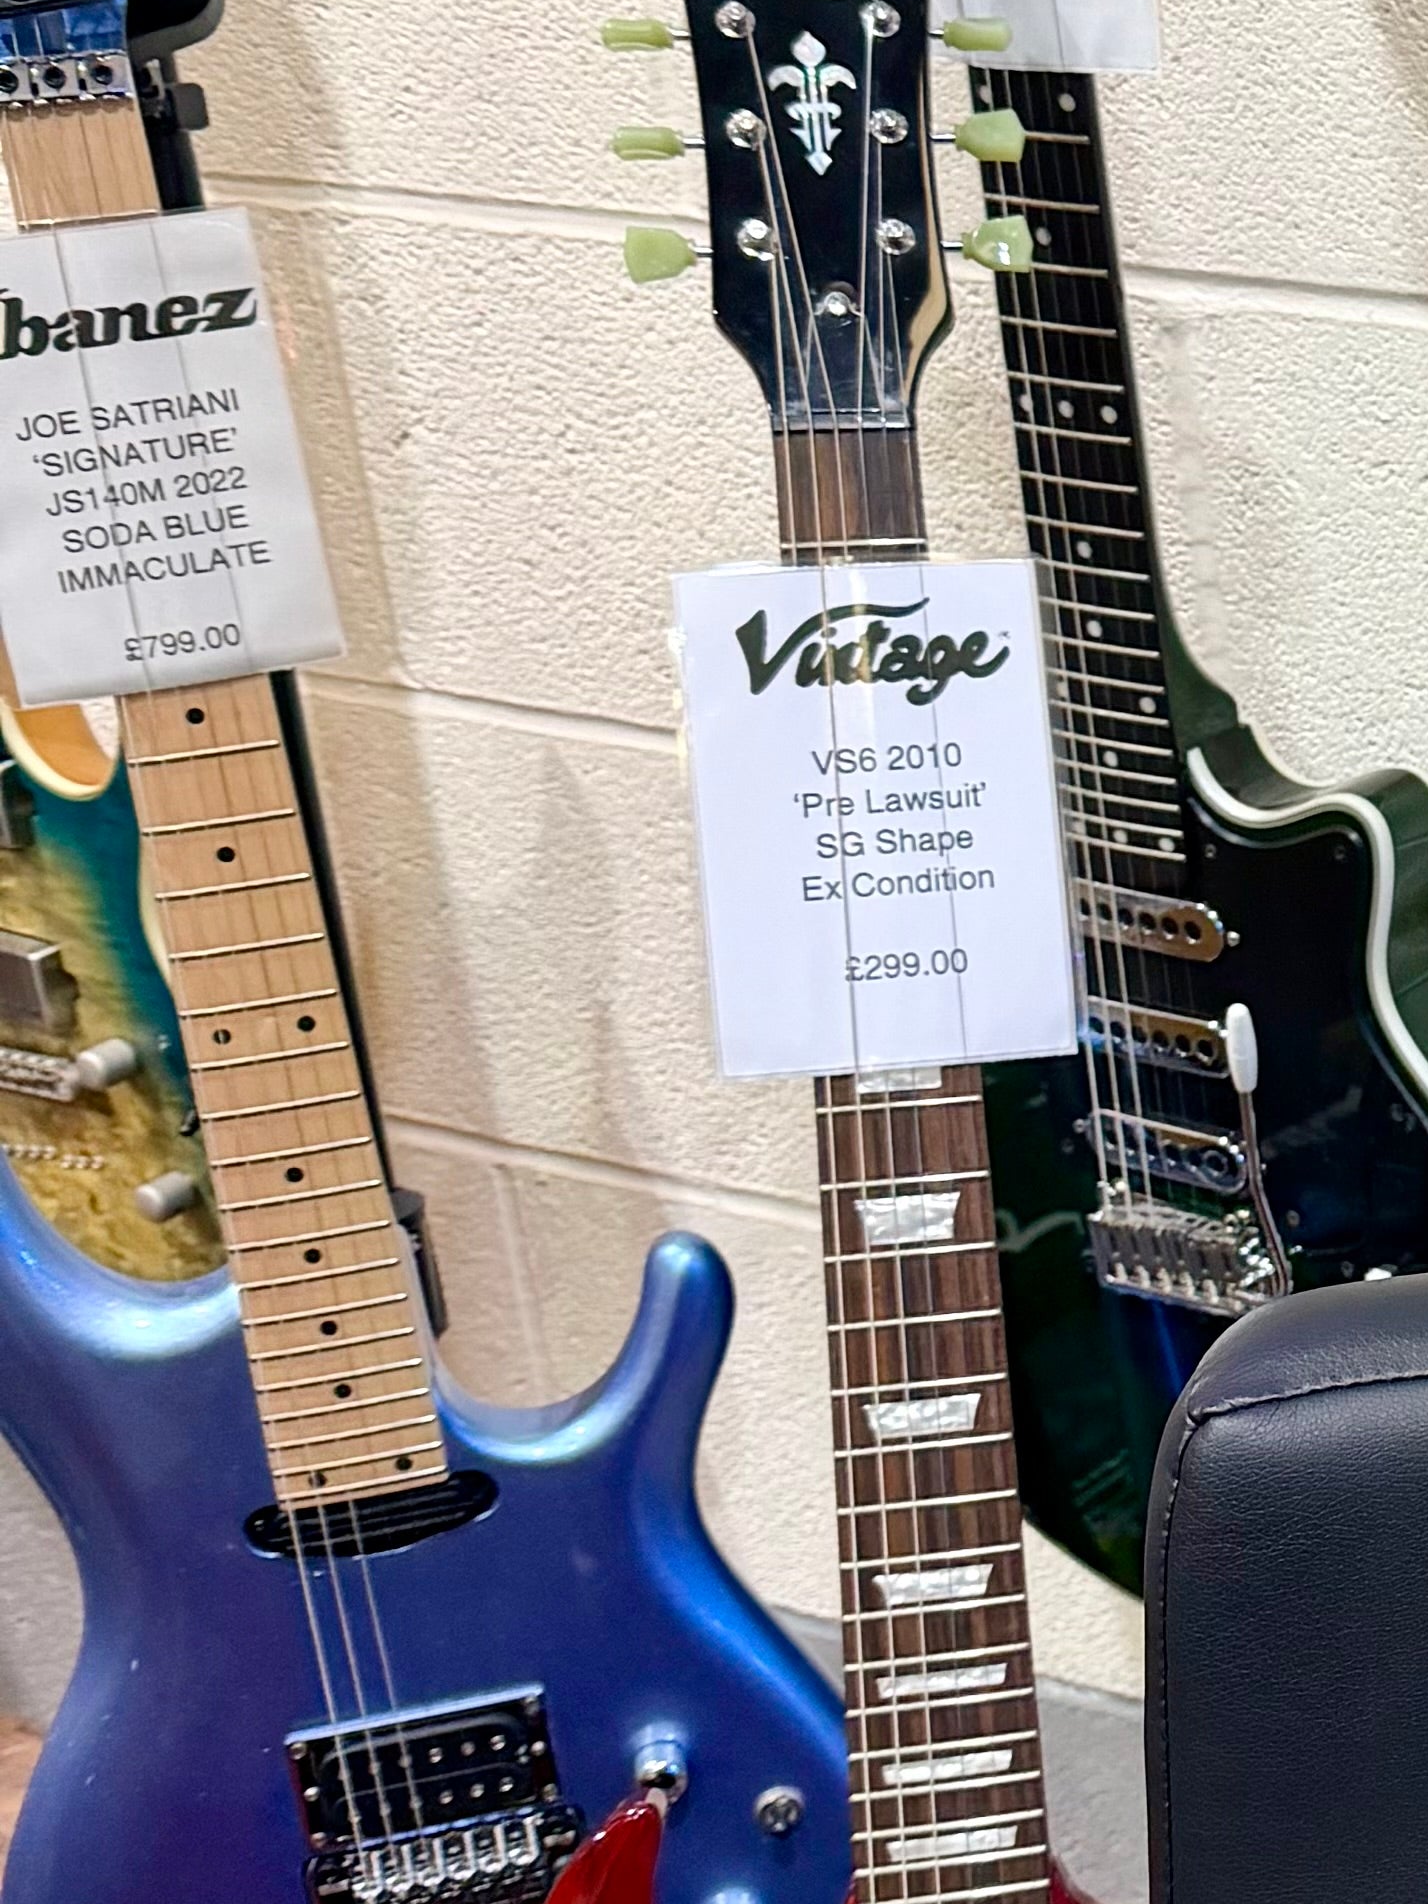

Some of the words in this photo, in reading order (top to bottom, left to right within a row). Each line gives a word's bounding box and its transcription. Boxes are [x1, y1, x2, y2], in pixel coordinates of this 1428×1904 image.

[0, 287, 256, 360] banez
[16, 406, 81, 442] JOE
[91, 389, 240, 431] SATRIANI
[46, 481, 166, 516] JS140M
[176, 466, 248, 497] 2022
[63, 519, 157, 553] SODA
[165, 506, 250, 540] BLUE
[58, 540, 272, 594] IMMACULATE
[125, 623, 241, 662] £799.00
[735, 597, 1010, 706] Vintage
[812, 748, 878, 774] VS6
[887, 742, 962, 772] 2010
[816, 832, 866, 858] SG
[876, 828, 974, 858] Shape
[802, 877, 843, 901] Ex
[851, 867, 995, 898] Condition
[845, 949, 969, 982] £299.00
